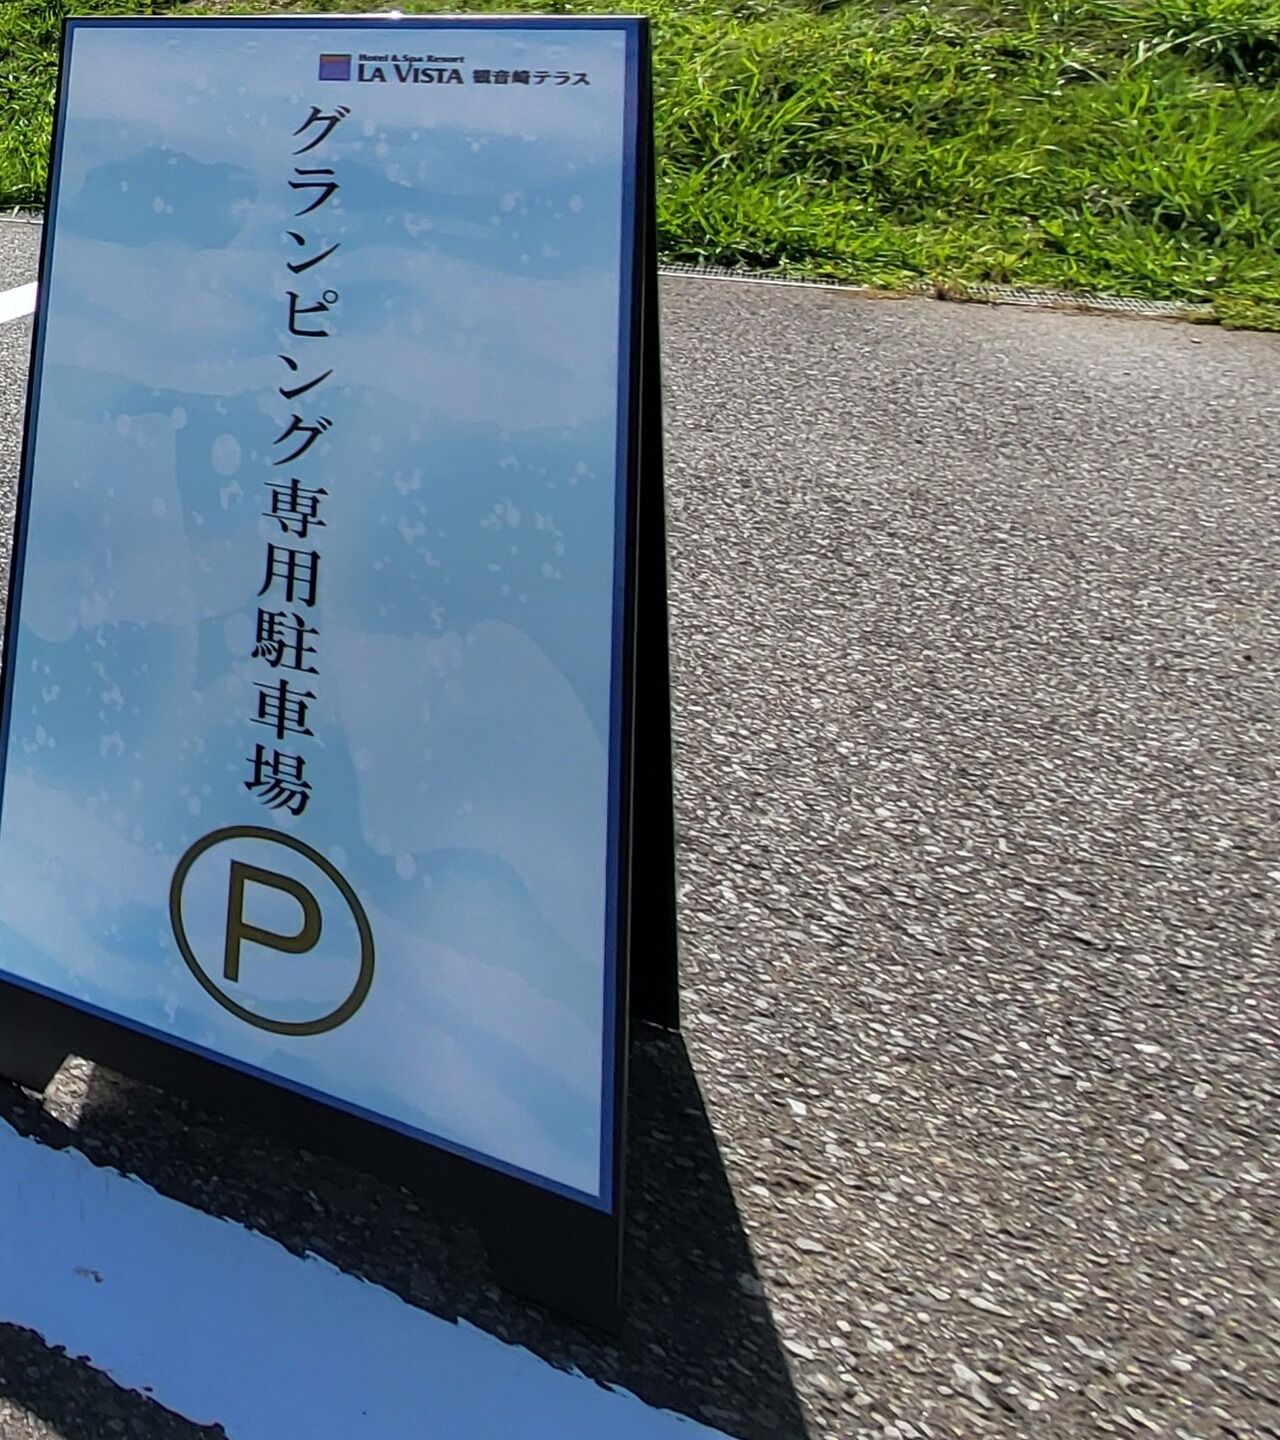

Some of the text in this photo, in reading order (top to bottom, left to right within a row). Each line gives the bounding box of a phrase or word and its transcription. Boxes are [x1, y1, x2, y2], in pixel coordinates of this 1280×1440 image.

[358, 53, 389, 62] Hotel
[401, 54, 424, 63] Spa
[426, 54, 465, 63] Resort
[358, 62, 387, 83] LA
[392, 62, 465, 85] VISTA
[244, 104, 351, 817] グランピング専用駐車場
[223, 858, 323, 983] P
